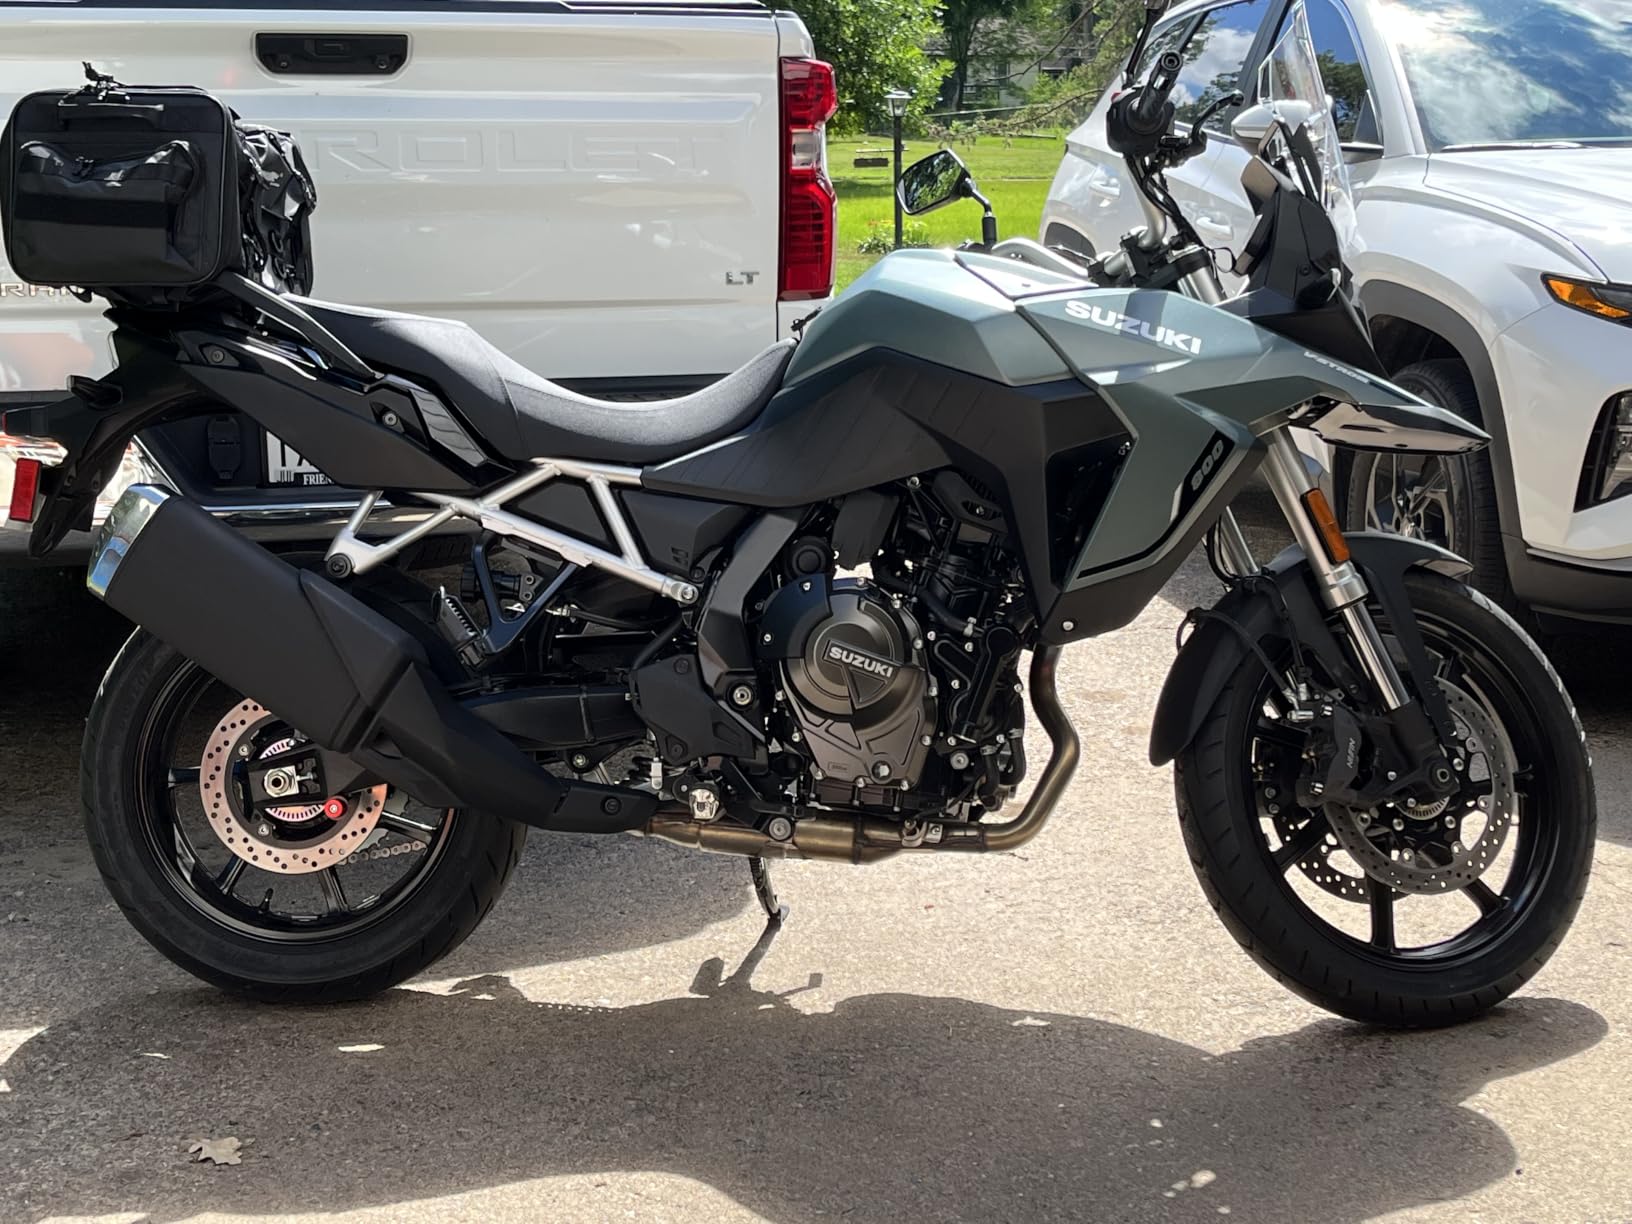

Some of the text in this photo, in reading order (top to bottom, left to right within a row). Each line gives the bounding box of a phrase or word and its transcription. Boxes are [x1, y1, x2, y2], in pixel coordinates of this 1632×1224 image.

[726, 271, 760, 285] LT
[1065, 300, 1202, 355] SUZUKI
[1191, 440, 1224, 491] 800
[829, 646, 893, 678] SUZUKI
